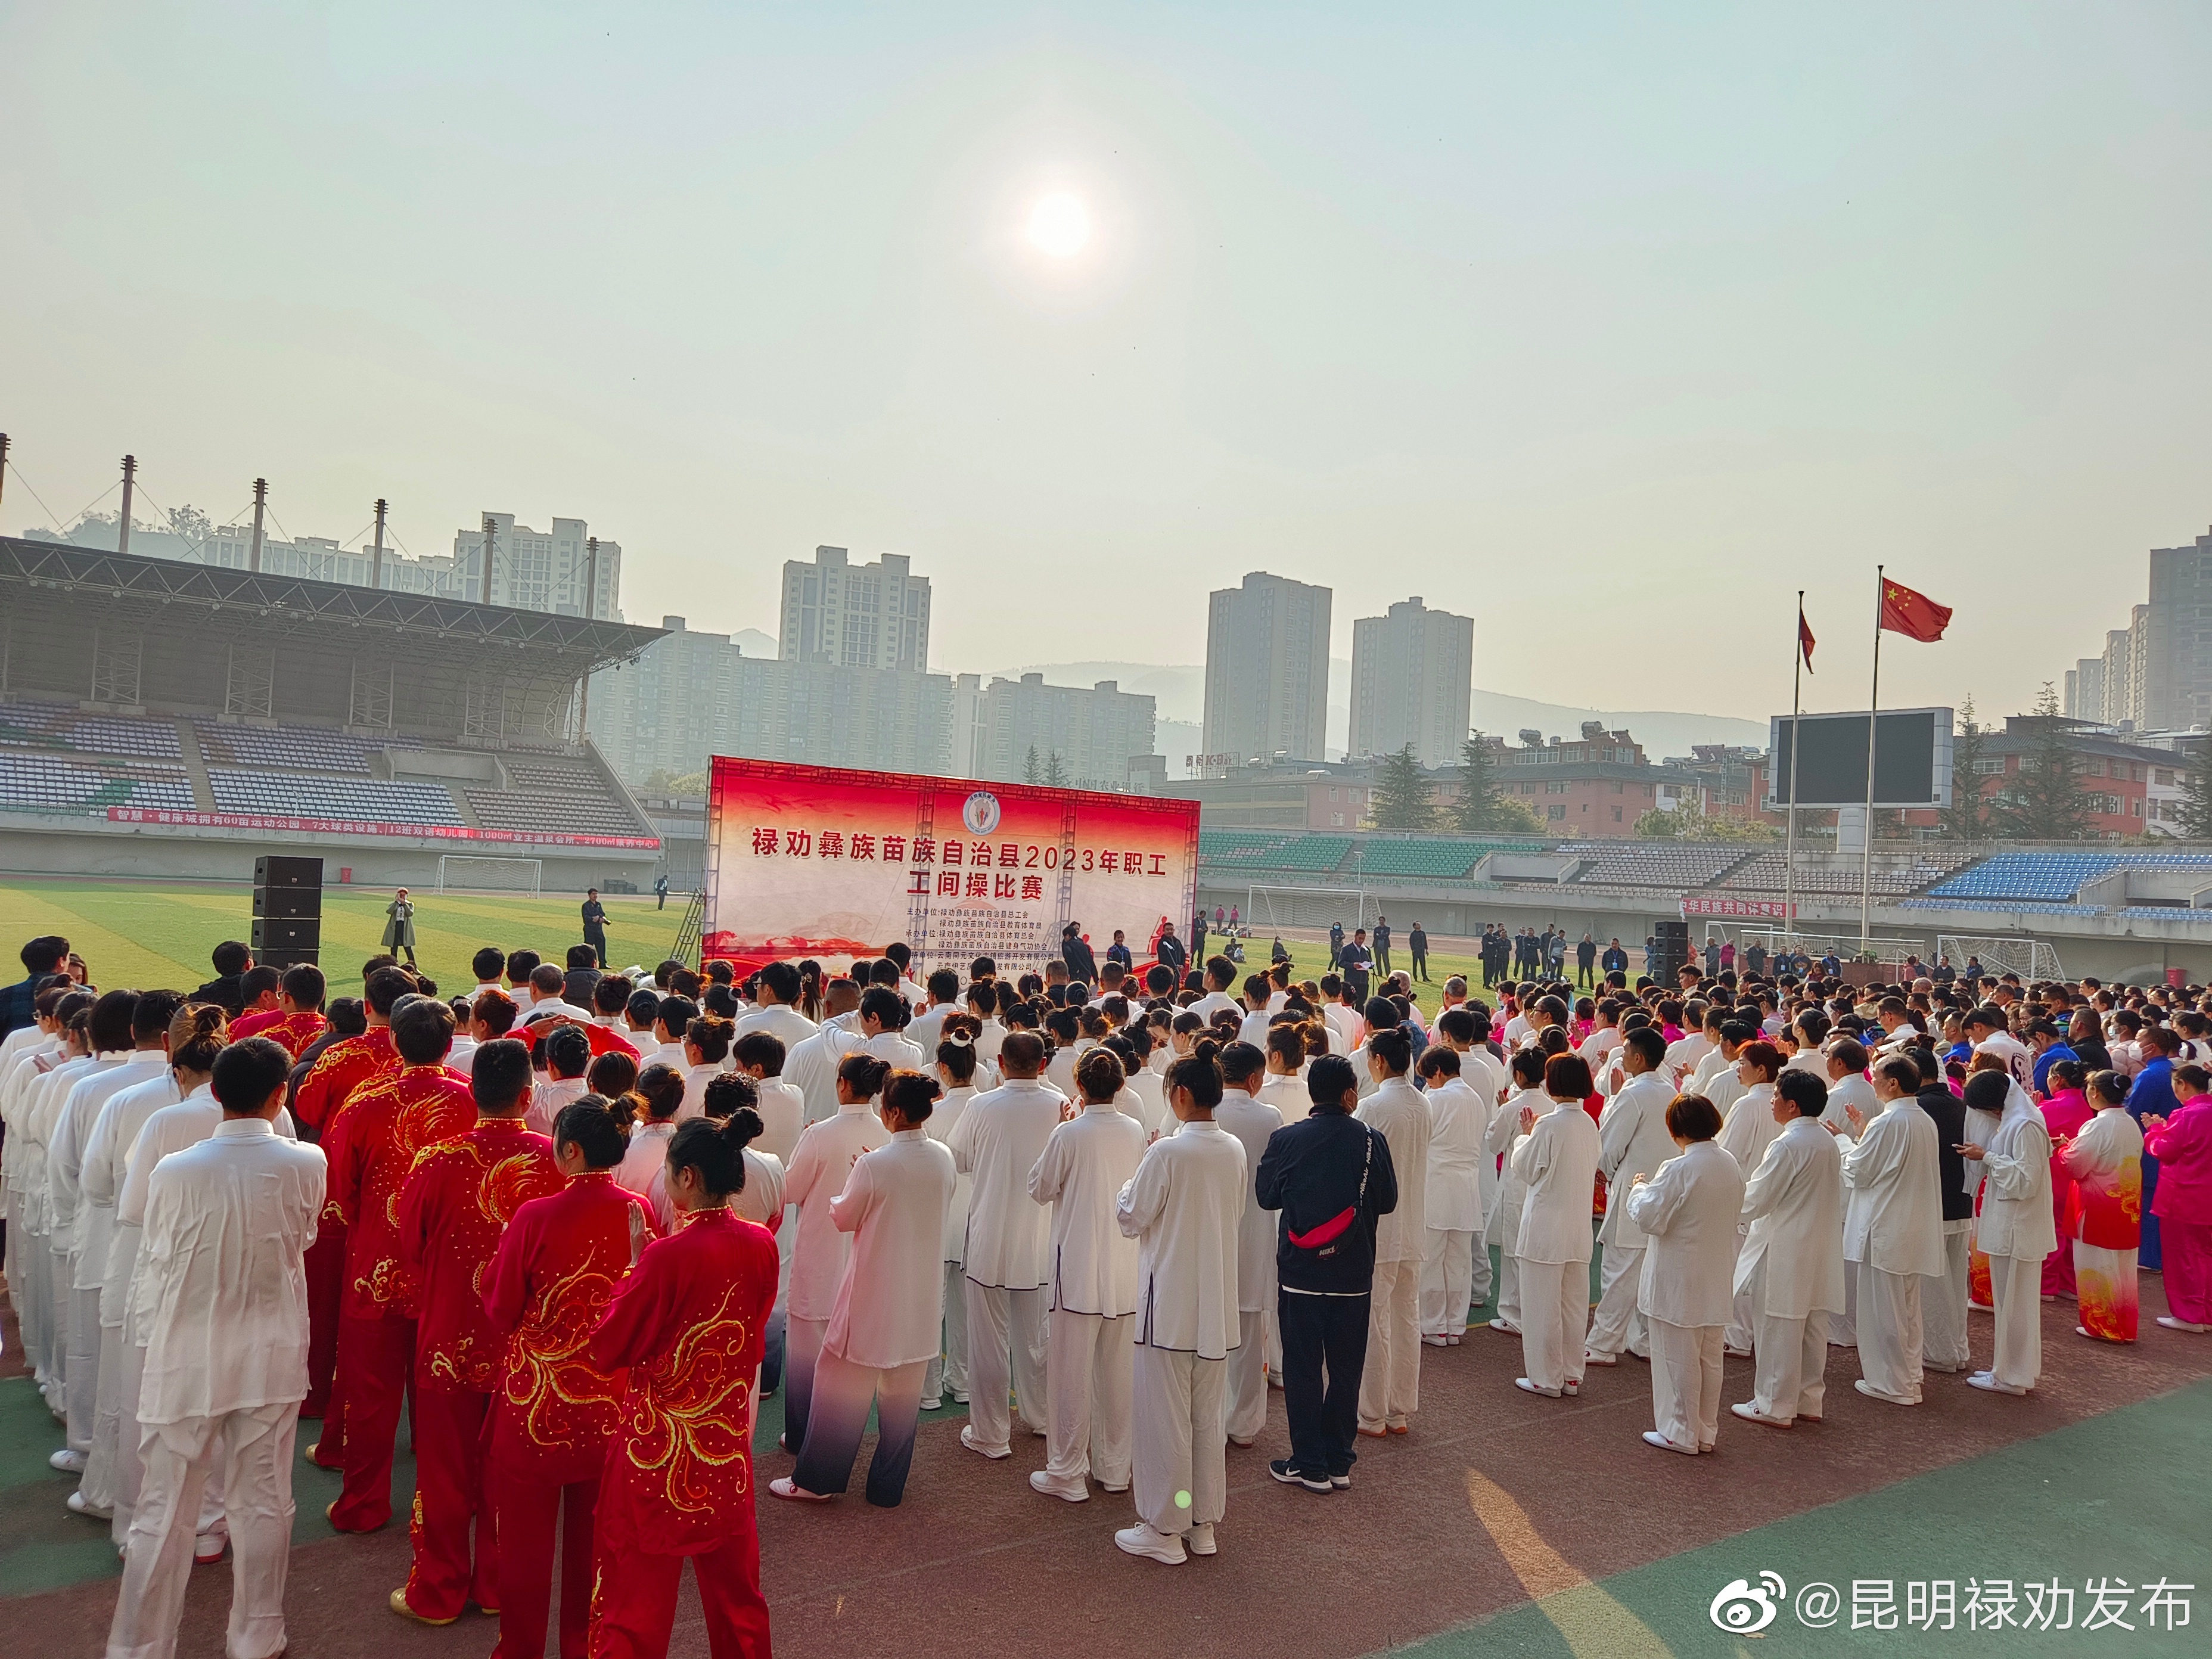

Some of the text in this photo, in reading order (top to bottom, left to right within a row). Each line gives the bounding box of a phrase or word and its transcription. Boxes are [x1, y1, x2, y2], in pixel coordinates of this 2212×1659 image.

[752, 828, 1166, 876] 禄劝彝族苗族自治县2023年职工
[907, 871, 1043, 900] 工间操比赛
[939, 920, 1042, 930] 禄劝彝族苗族自治县教育体育局
[938, 940, 1048, 950] 禄劝彝族苗族自治县健身气功协会
[1319, 1245, 1336, 1256] NIKE
